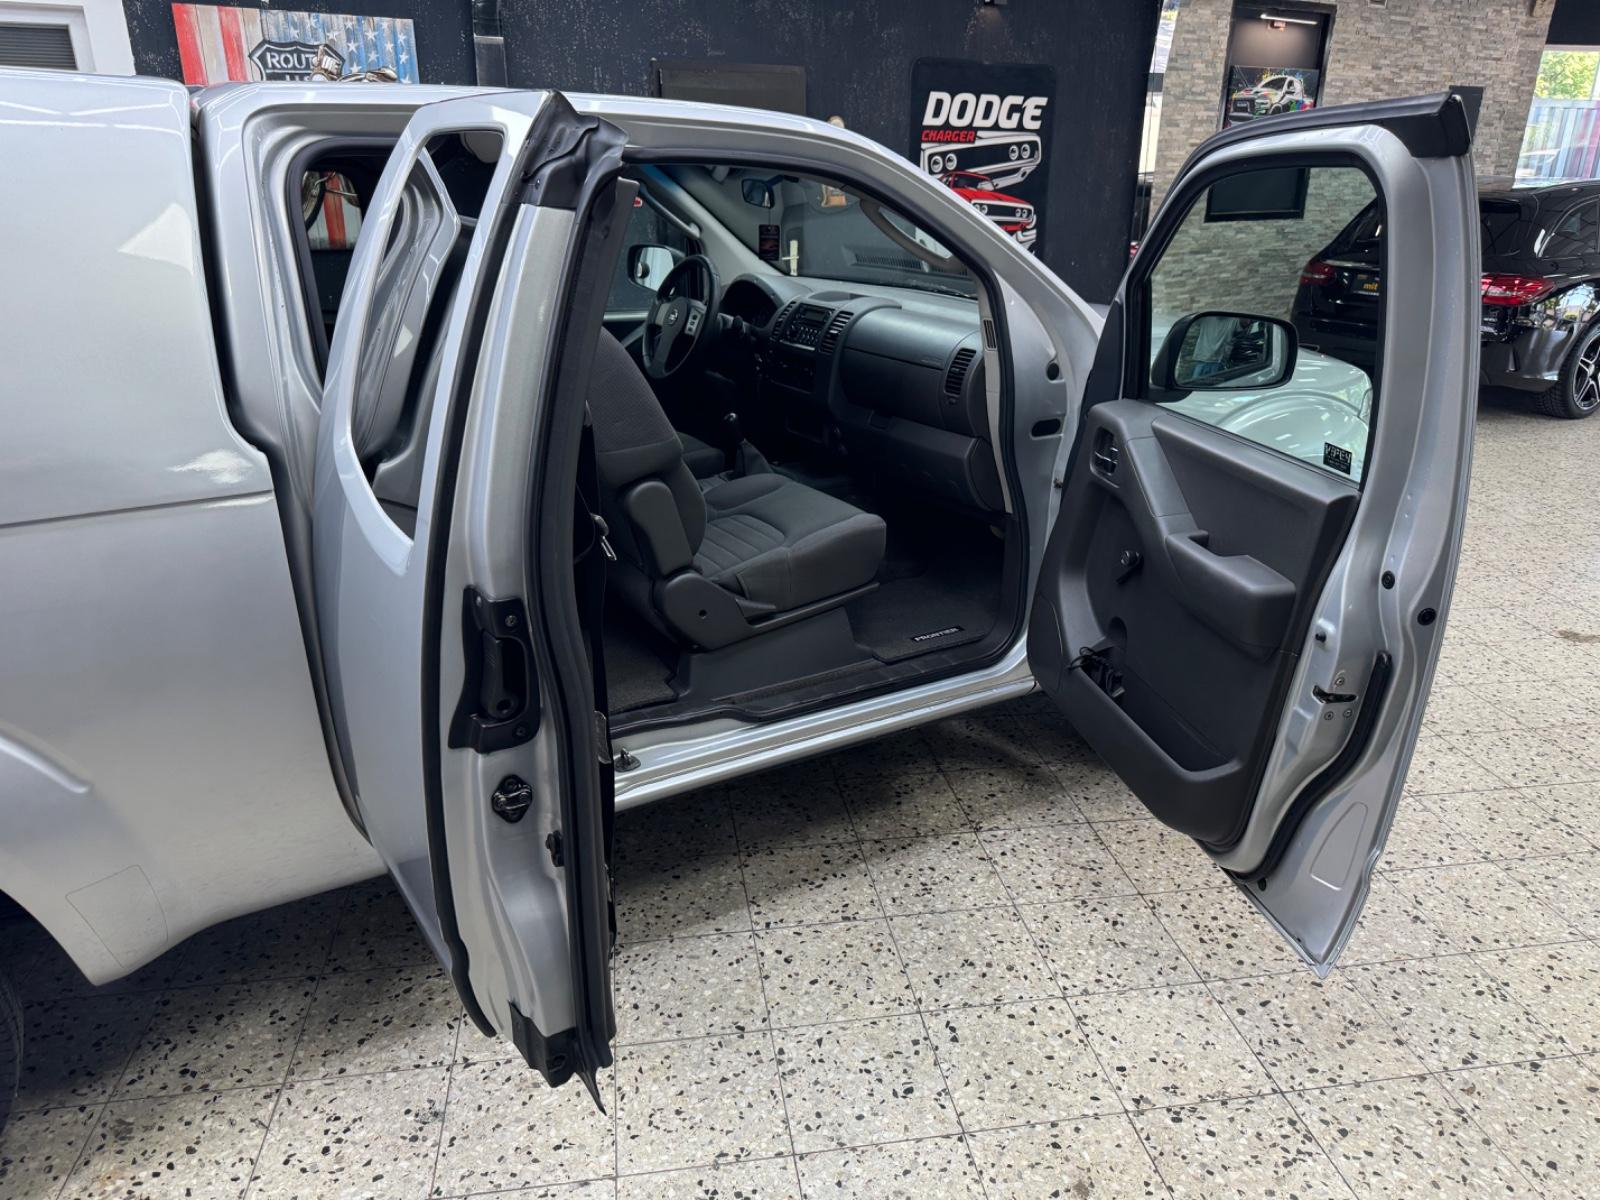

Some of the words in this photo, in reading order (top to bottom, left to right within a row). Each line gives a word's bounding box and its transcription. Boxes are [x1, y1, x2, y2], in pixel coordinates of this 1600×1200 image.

[265, 51, 314, 69] ROUT
[921, 90, 1048, 130] DODGE
[921, 130, 976, 143] CHARGER
[914, 627, 960, 642] FRONTIER
